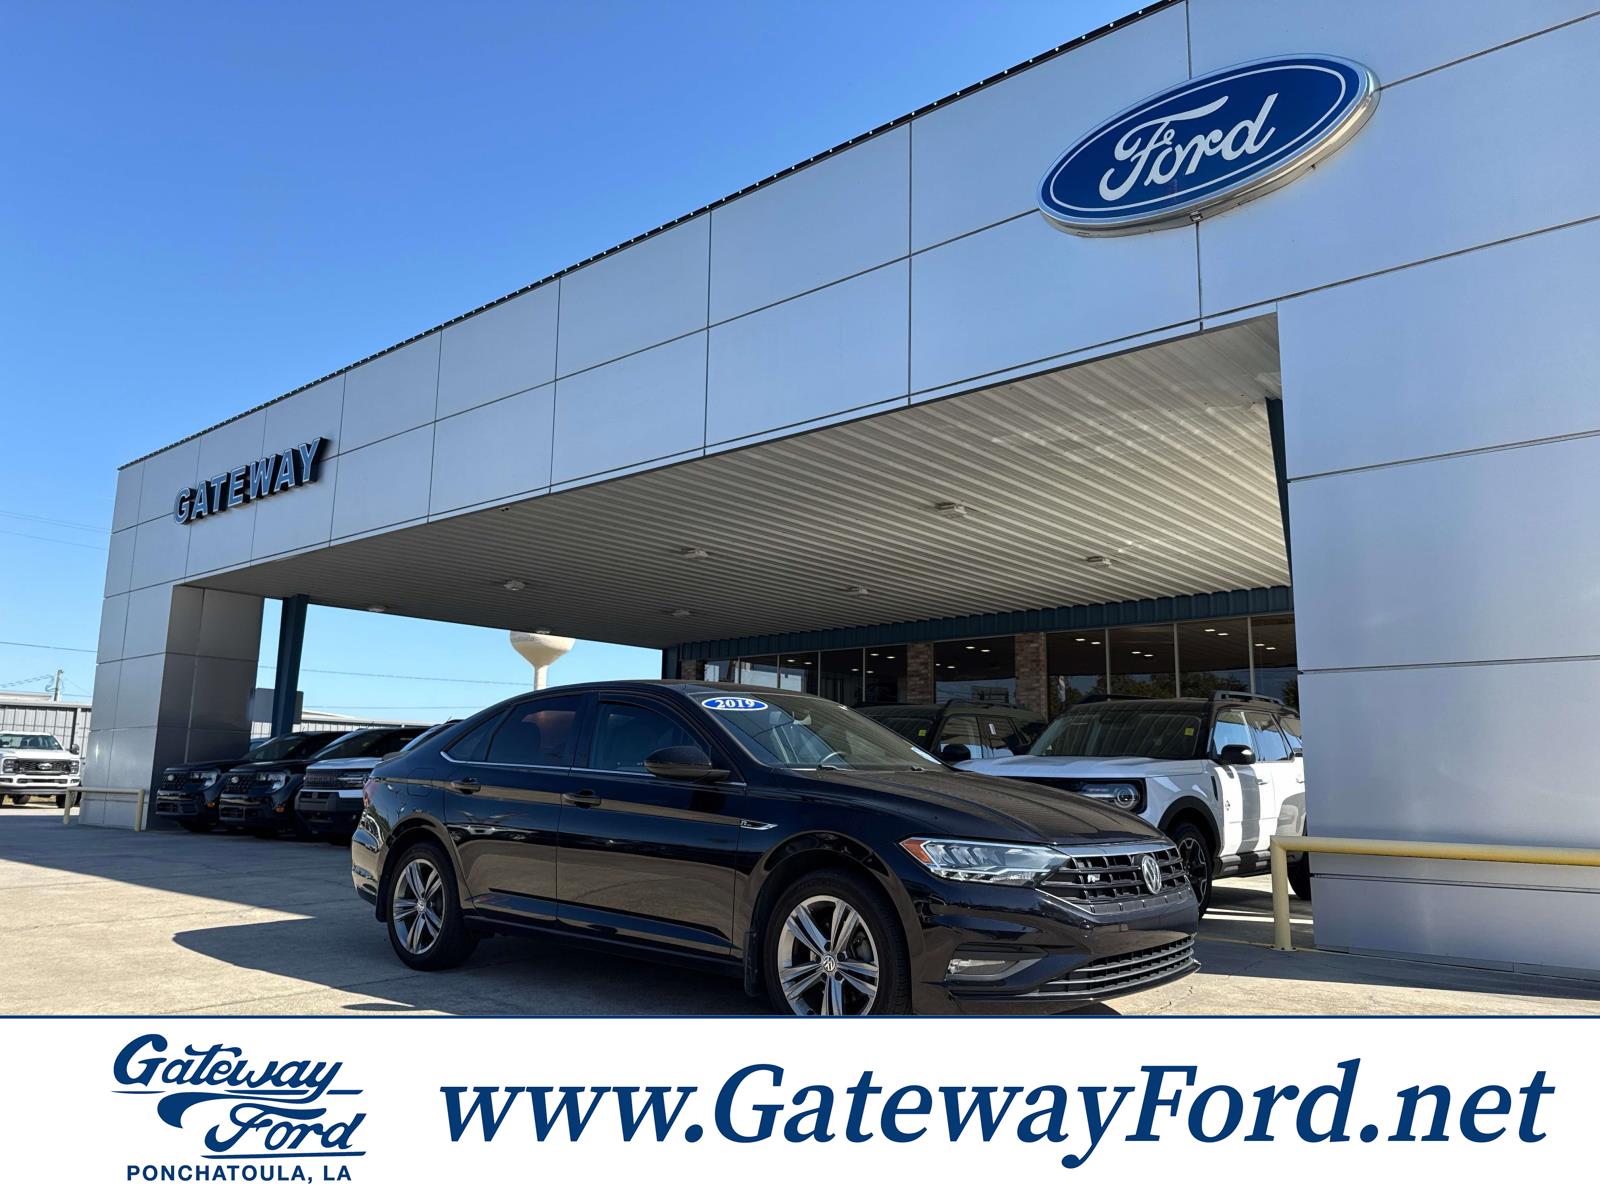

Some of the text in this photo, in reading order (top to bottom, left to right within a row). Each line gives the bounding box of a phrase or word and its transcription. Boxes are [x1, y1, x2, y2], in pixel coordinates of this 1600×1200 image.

[1098, 92, 1279, 202] Ford
[174, 436, 328, 525] GATEWAY
[715, 699, 756, 709] 2019
